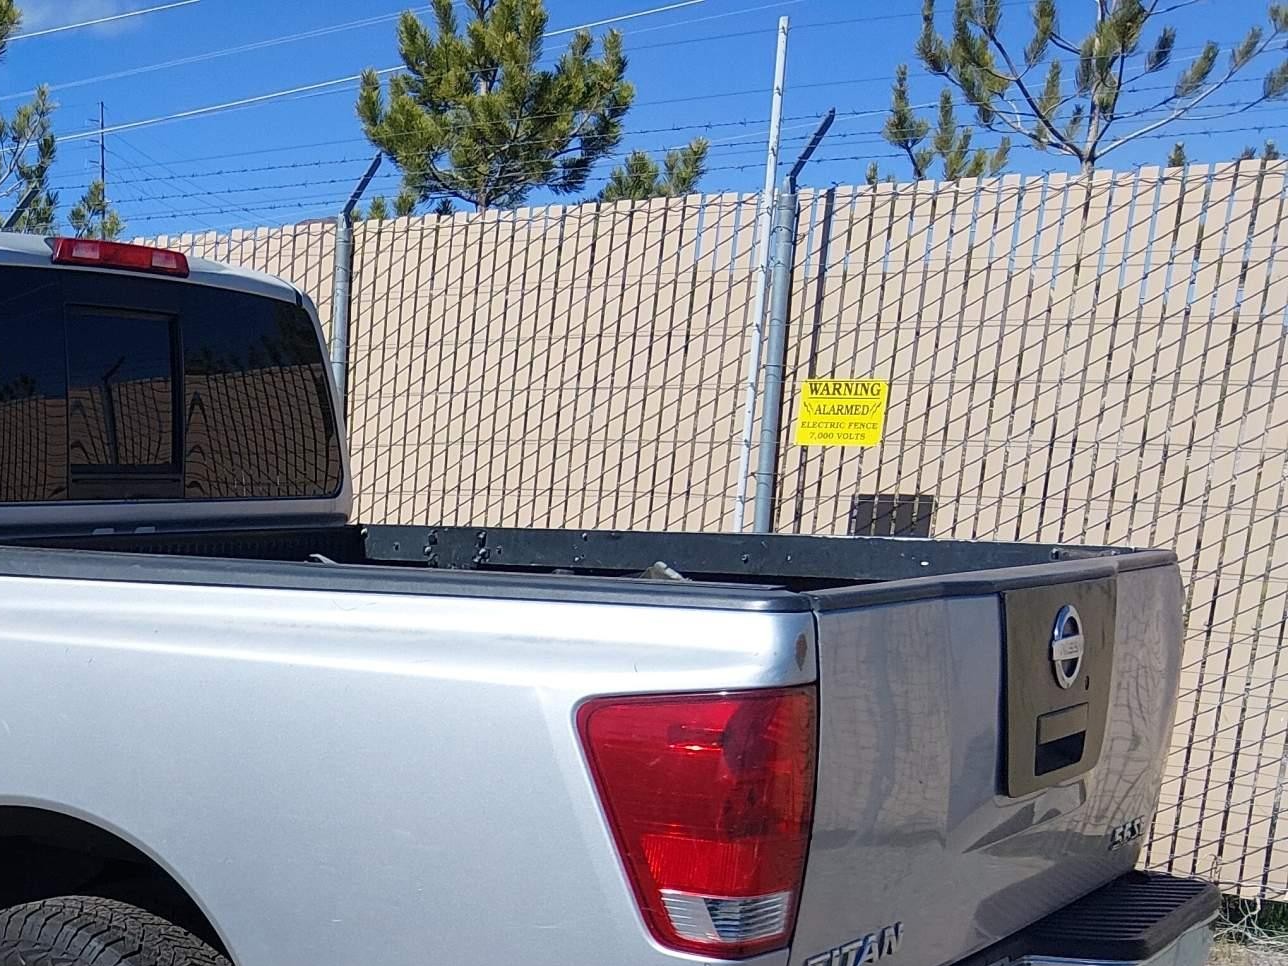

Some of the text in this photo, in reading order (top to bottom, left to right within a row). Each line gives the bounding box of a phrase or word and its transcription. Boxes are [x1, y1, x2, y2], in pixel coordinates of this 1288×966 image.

[808, 382, 881, 397] WARNING
[814, 404, 870, 415] ALARMED
[800, 421, 878, 430] ELECTRIC FENCE
[809, 431, 866, 441] 7,000 VOLTS
